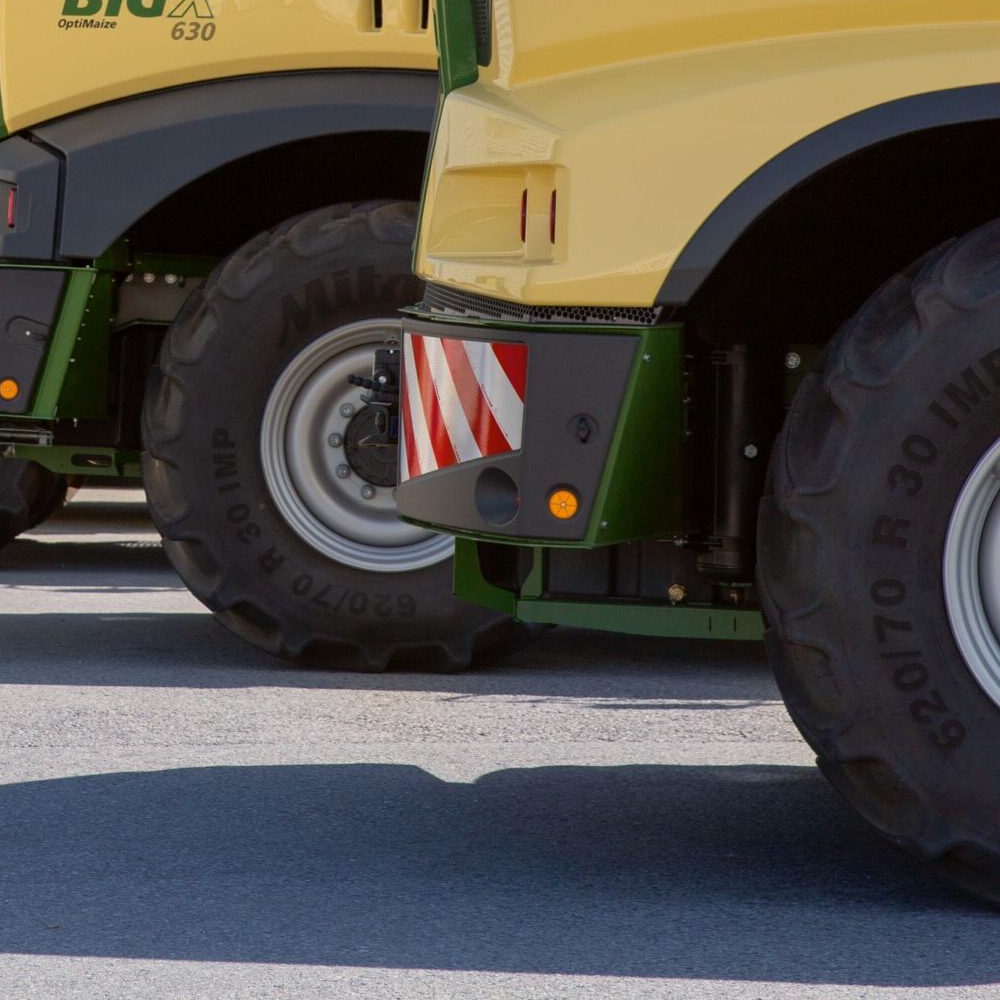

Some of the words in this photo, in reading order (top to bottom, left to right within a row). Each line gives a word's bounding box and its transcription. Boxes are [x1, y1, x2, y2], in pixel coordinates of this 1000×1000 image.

[57, 18, 117, 30] OptiMaize
[170, 21, 217, 42] 630
[212, 428, 241, 495] IMP
[887, 434, 938, 497] 30
[872, 515, 911, 550] R
[871, 578, 966, 751] 620/70
